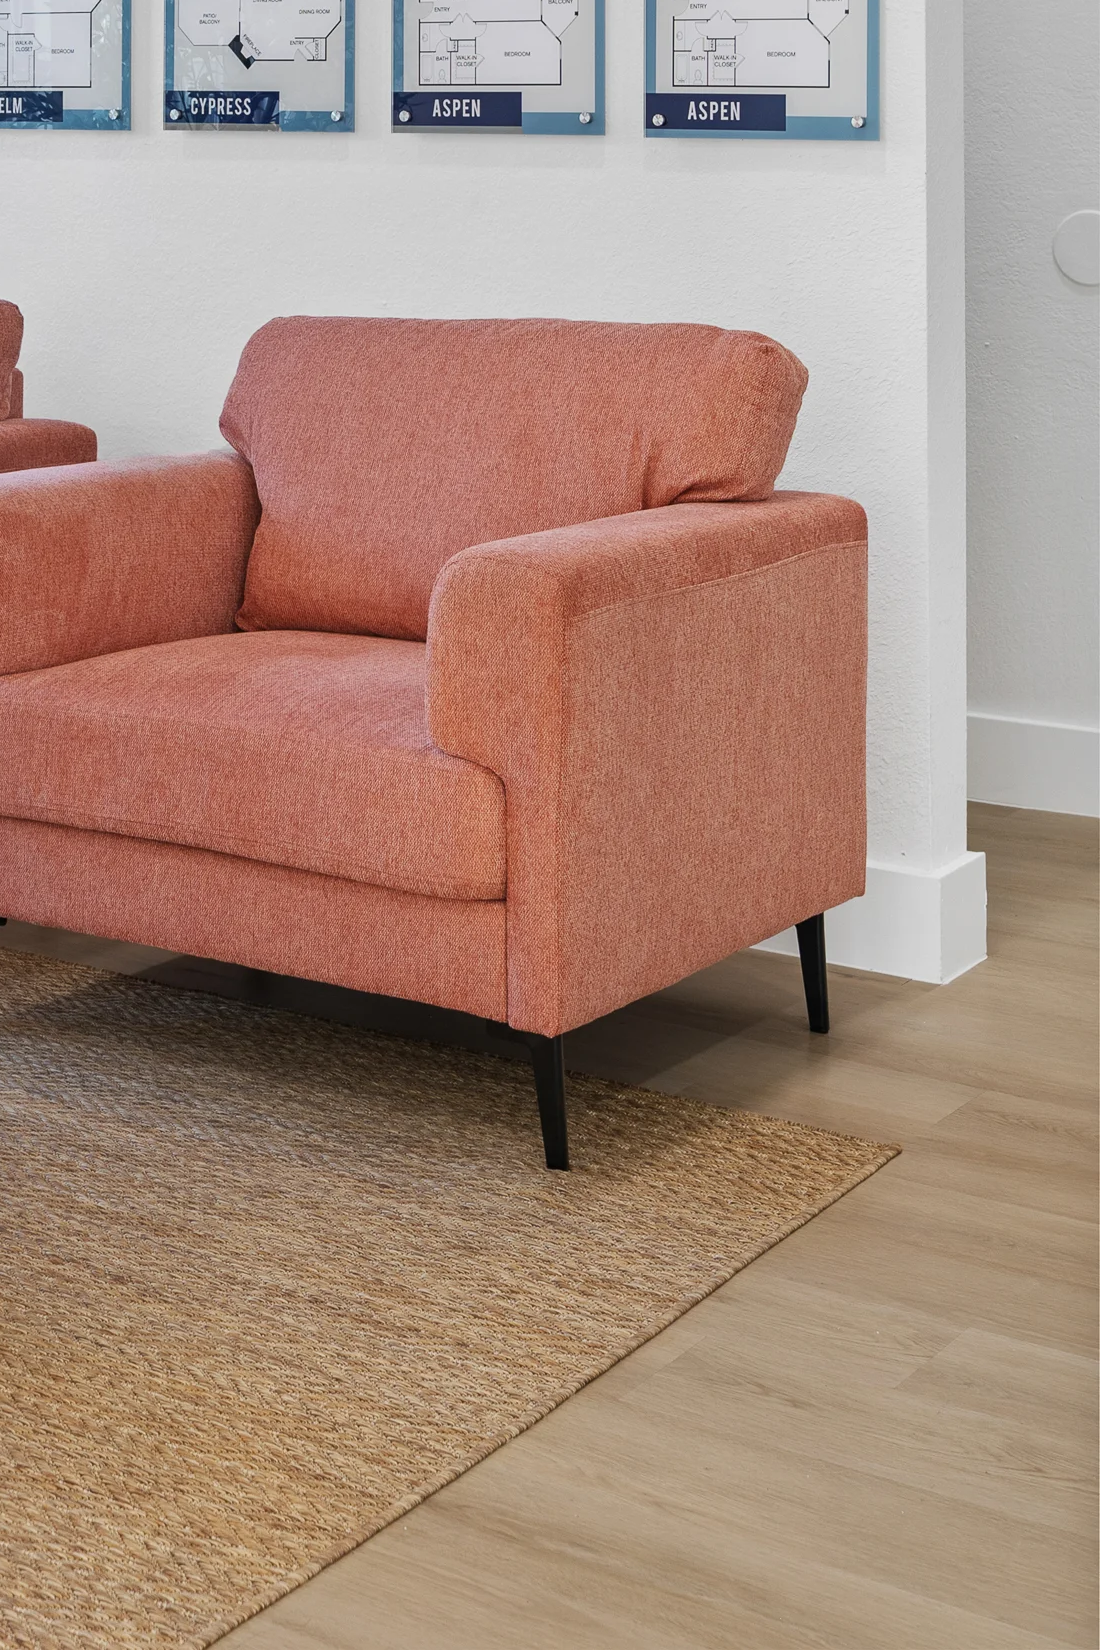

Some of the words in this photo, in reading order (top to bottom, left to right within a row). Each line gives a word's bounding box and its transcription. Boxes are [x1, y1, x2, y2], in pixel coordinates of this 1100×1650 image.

[243, 34, 262, 56] FIREPLACE
[190, 98, 252, 115] CYPRESS
[432, 99, 481, 118] ASPEN
[687, 101, 741, 121] ASPEN
